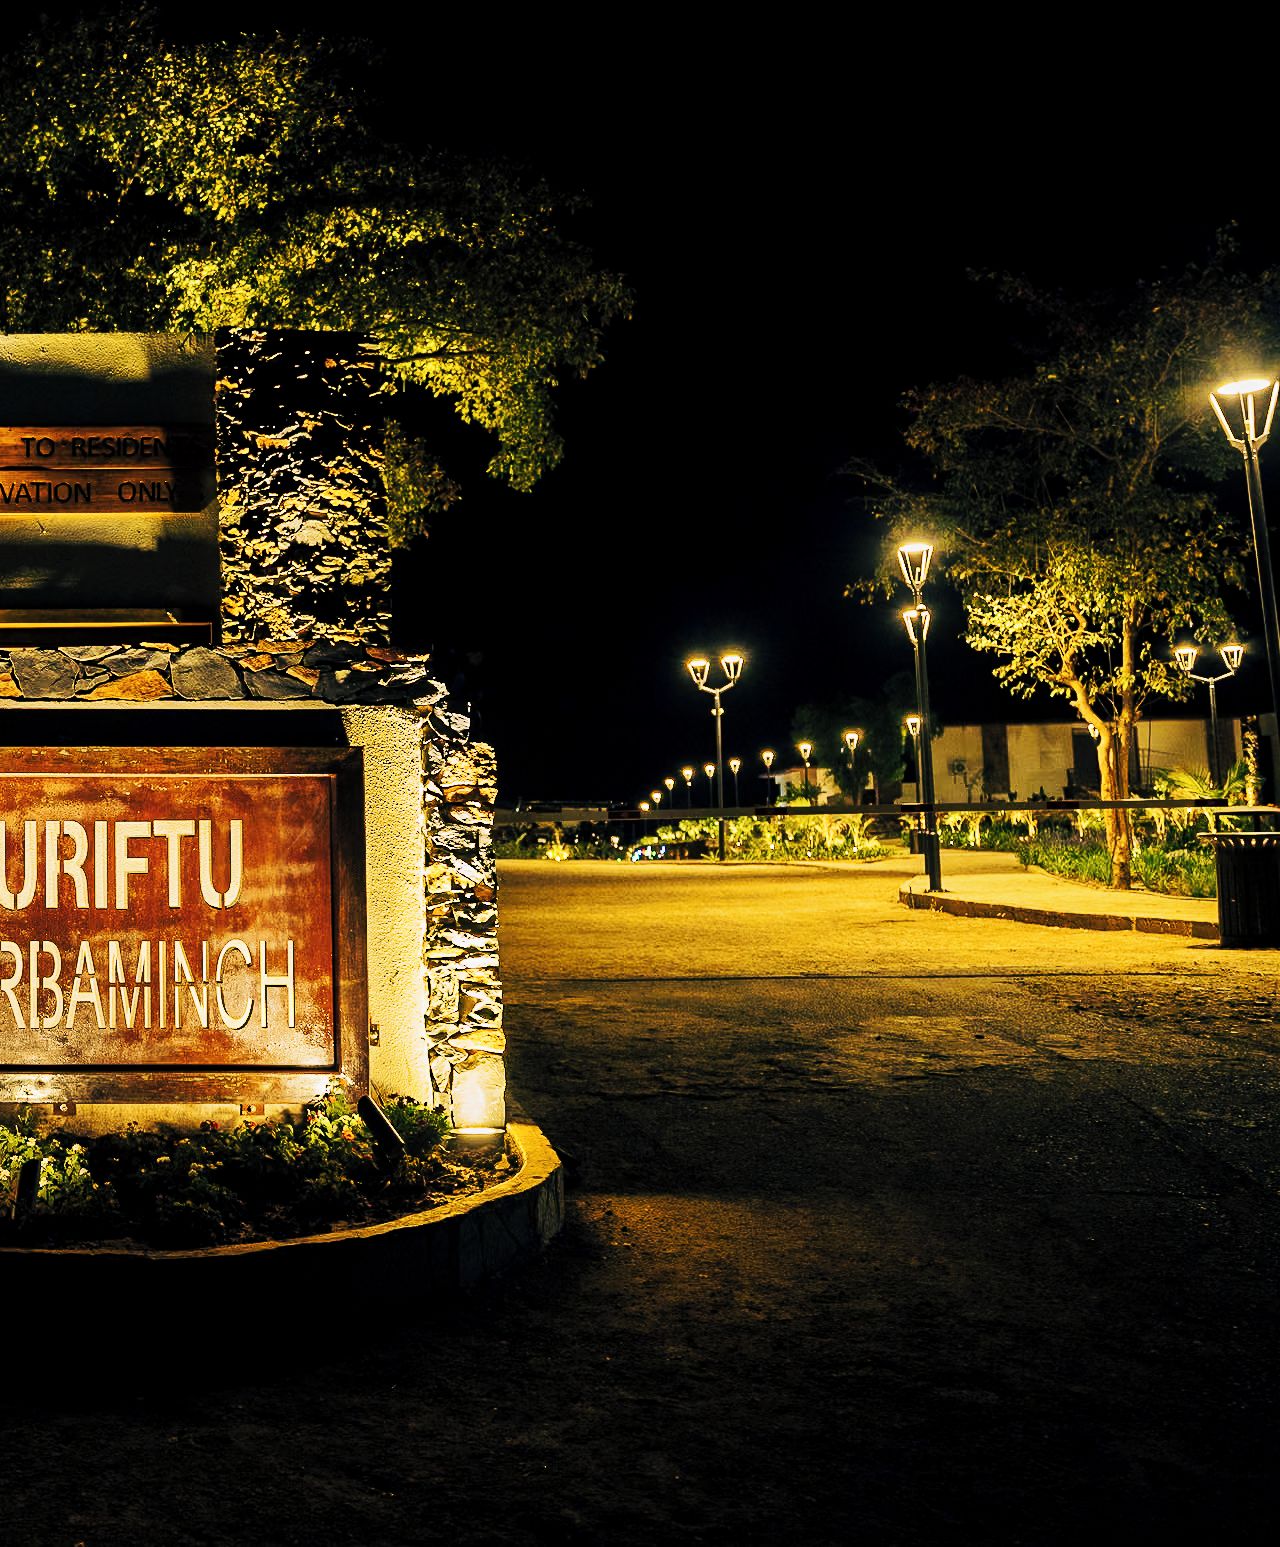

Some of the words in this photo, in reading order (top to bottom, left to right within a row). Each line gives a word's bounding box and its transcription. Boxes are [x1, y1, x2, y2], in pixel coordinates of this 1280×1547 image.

[21, 437, 55, 458] TO
[71, 437, 172, 459] RESIDEN
[117, 481, 177, 503] ONLY
